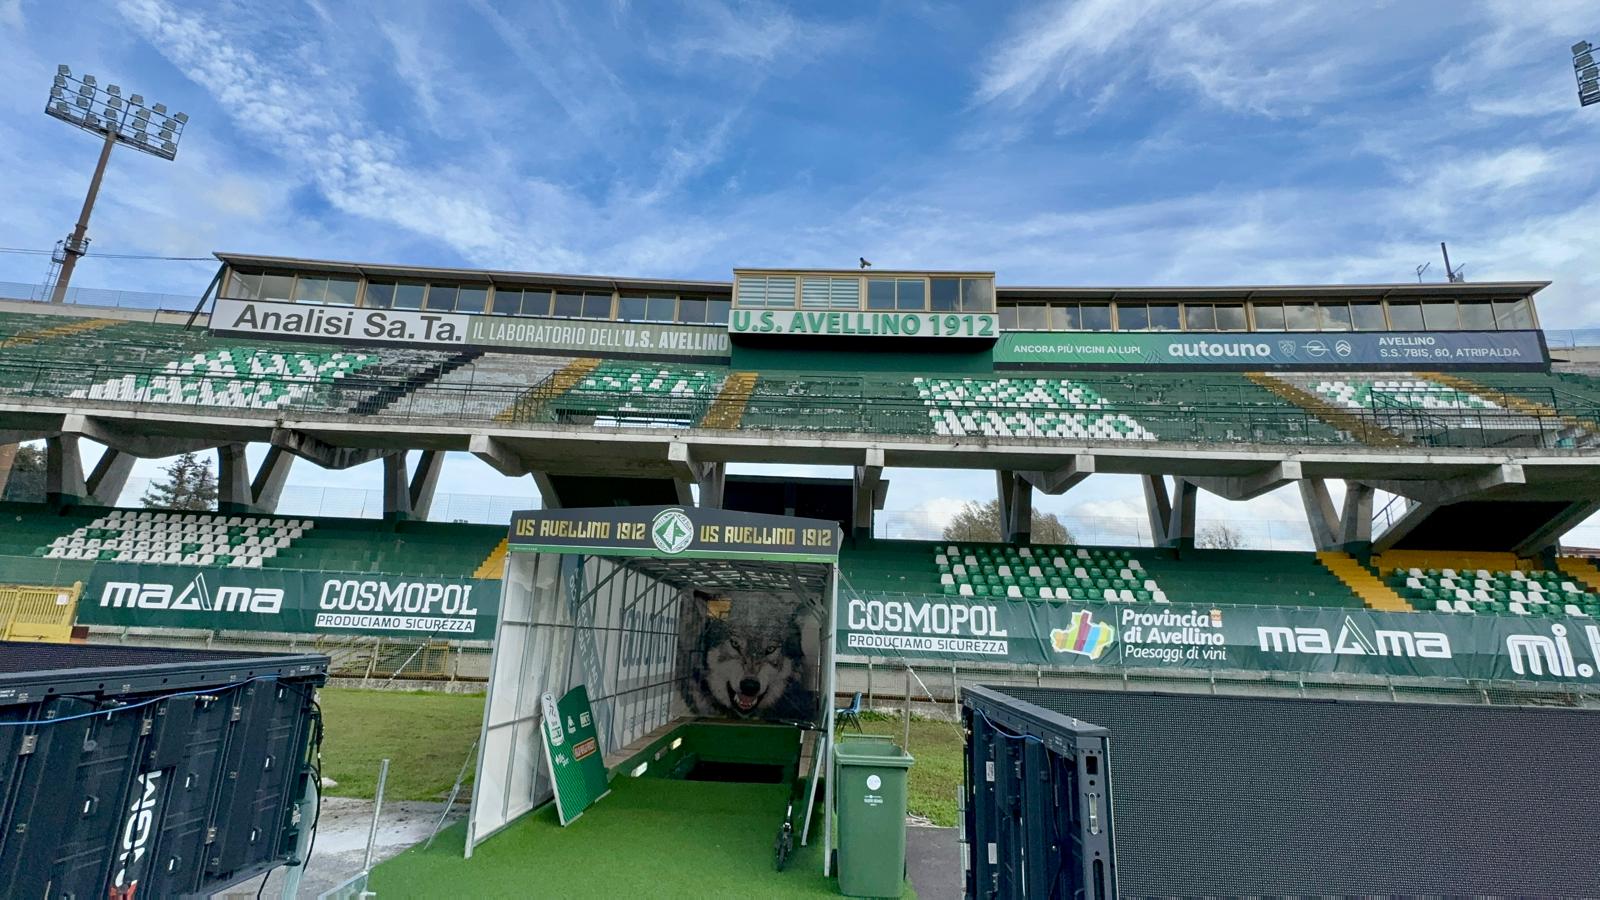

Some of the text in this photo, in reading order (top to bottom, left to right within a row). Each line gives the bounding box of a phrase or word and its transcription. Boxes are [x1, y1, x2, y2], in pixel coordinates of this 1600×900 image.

[232, 304, 462, 342] Analisi Sa.Ta.
[732, 310, 994, 337] U.S. AVELLINO 1912
[473, 321, 484, 340] IL
[489, 323, 586, 345] LABORATORIO
[658, 331, 729, 351] AVELLINO
[1378, 336, 1435, 346] AVELLINO
[1013, 345, 1055, 353] ANCORA
[1057, 343, 1073, 353] PIÙ
[1075, 345, 1105, 354] VICINI
[1168, 341, 1271, 357] autouno
[1455, 348, 1521, 357] ATRIPALDA
[516, 519, 536, 536] US
[540, 519, 611, 539] AVELLINO
[616, 522, 646, 540] 1912
[700, 525, 720, 543] US
[724, 526, 796, 545] AVELLINO
[802, 528, 832, 547] 1912
[319, 579, 478, 616] COSMOPOL
[317, 615, 473, 631] PRODUCIAMO SICUREZZA
[848, 599, 1008, 637] COSMOPOL
[1122, 609, 1210, 628] Provincia
[849, 635, 1006, 653] PRODUCIAMO SICUREZZA
[1124, 626, 1225, 646] di Avellino
[1125, 645, 1227, 662] Paesaggi di vini
